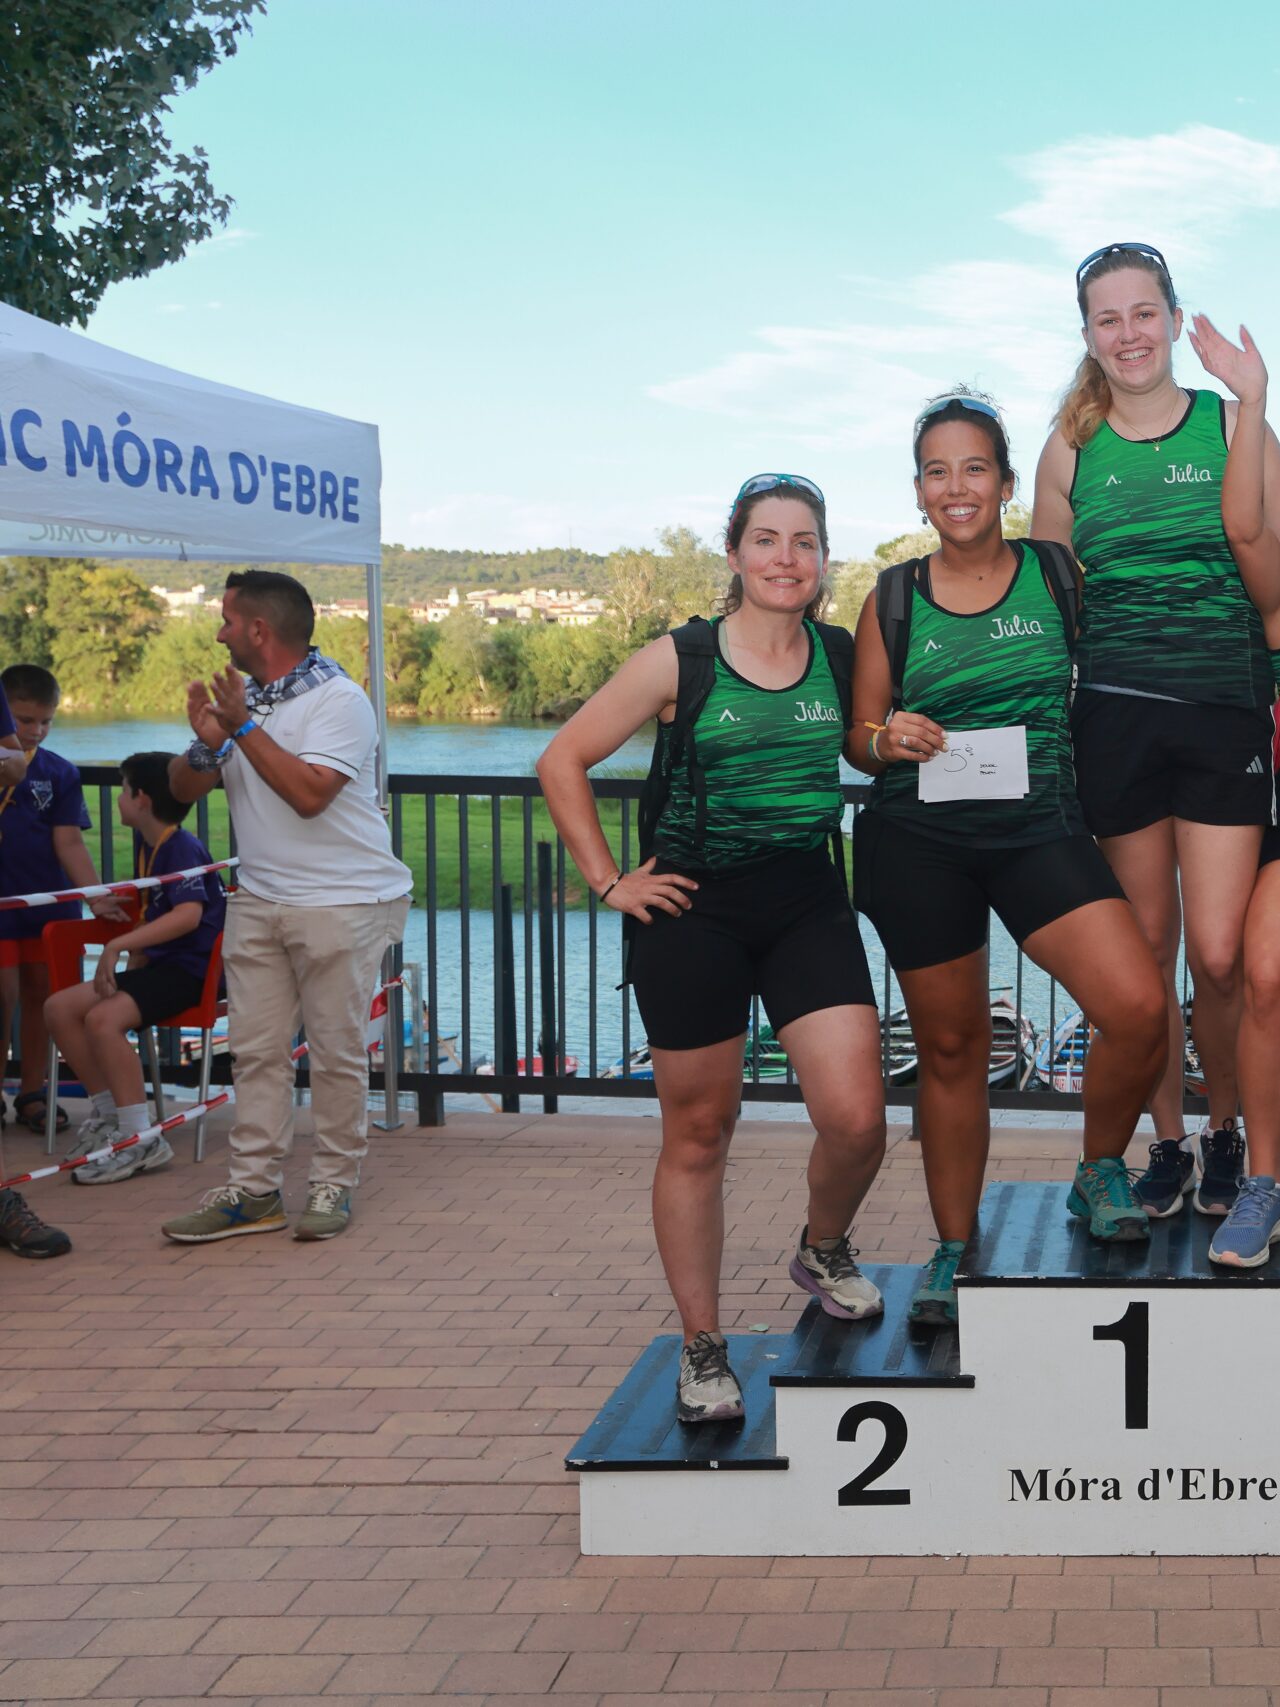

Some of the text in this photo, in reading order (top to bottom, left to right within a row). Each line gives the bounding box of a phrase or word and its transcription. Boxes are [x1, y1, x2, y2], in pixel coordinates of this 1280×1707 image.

[228, 452, 360, 523] D'EBRE
[1163, 463, 1213, 484] Júlia
[989, 614, 1044, 639] Júlia
[794, 700, 840, 722] Júlia
[1093, 1302, 1148, 1429] 1
[837, 1401, 910, 1506] 2
[1008, 1467, 1278, 1502] Móra d'Ebre
